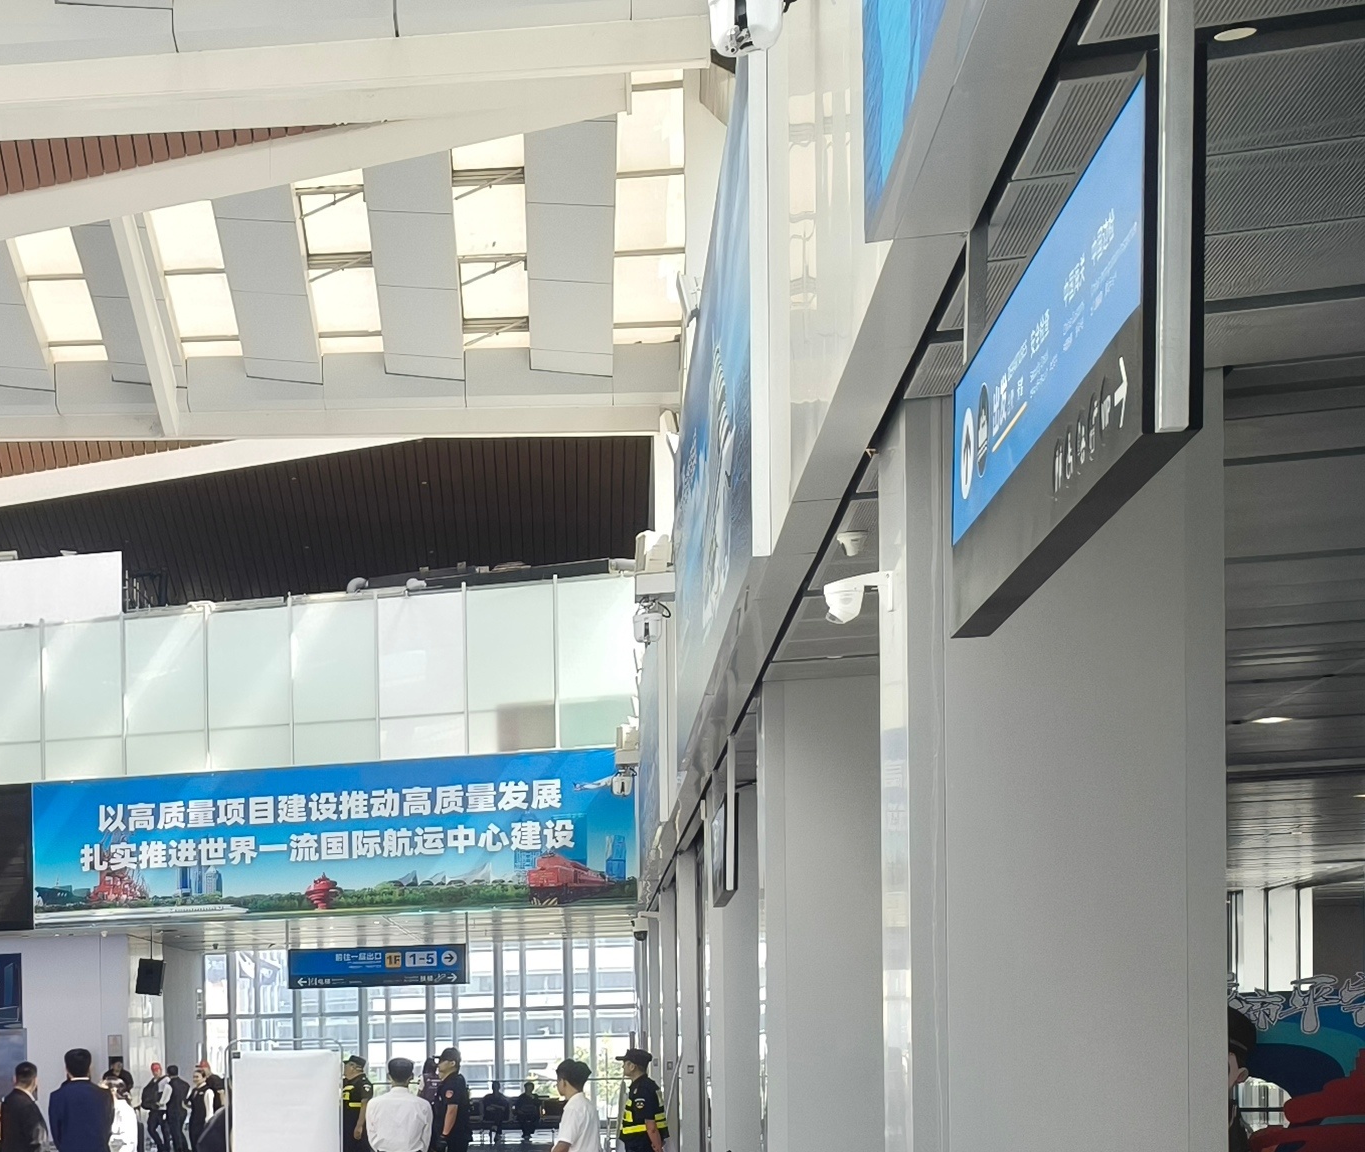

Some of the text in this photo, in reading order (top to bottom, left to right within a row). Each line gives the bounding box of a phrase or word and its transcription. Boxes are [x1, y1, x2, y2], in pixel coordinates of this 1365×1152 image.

[98, 779, 562, 832] 以高质量项目建设推动高质量发展
[80, 819, 575, 872] 扎实推进世界一流国际航运中心建设
[386, 955, 401, 966] 1F
[409, 953, 435, 965] 1-5
